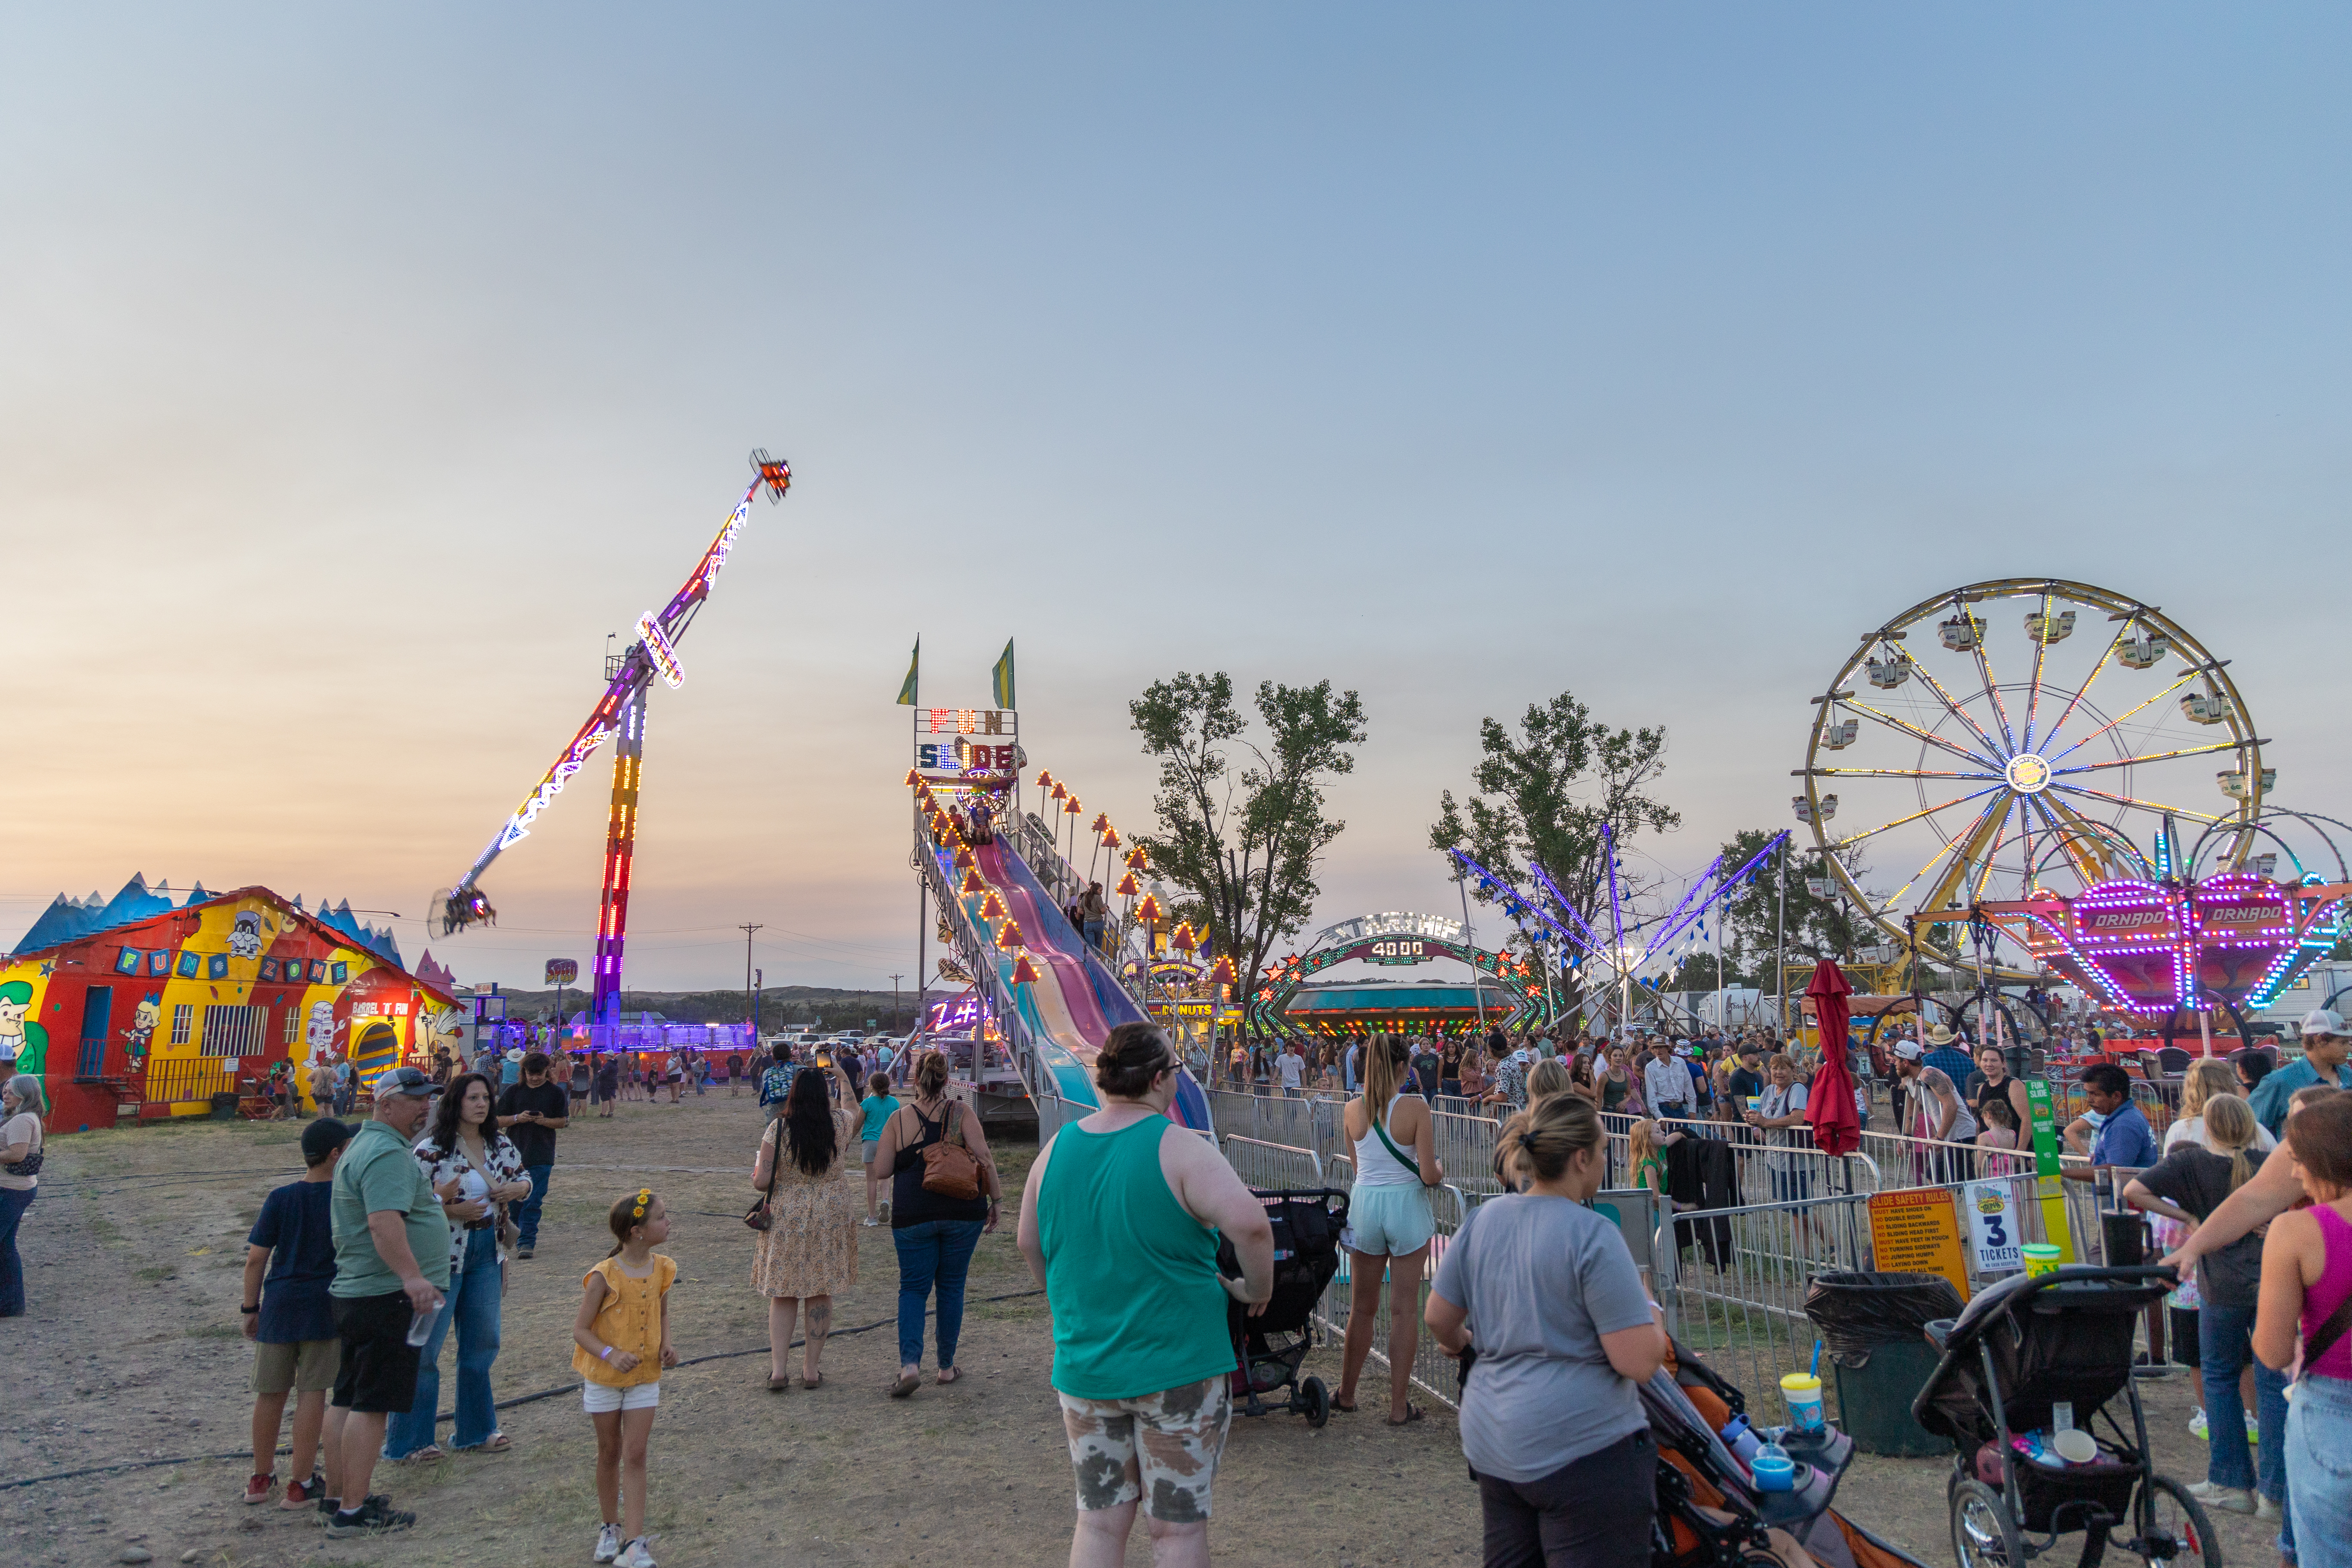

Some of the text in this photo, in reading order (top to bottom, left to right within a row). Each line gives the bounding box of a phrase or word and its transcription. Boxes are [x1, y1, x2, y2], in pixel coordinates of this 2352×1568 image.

[637, 616, 683, 686] SPEED
[931, 709, 1002, 735] FUN
[920, 744, 1013, 769] SLIDE
[2012, 758, 2043, 768] CENTURY
[2012, 764, 2040, 776] Thomas
[2014, 768, 2046, 784] Carnival
[1317, 911, 1468, 945] STARSHIP
[1372, 942, 1423, 956] 4000
[122, 954, 345, 979] FUN ZONE
[546, 960, 576, 983] SPEED
[352, 1002, 379, 1014] BARREL
[395, 1003, 408, 1015] FUN
[2030, 1089, 2047, 1098] SLIDE
[1871, 1191, 1949, 1207] SLIDE SAFETY RULES
[1983, 1215, 2007, 1247] 3
[1980, 1247, 2018, 1261] TICKETS
